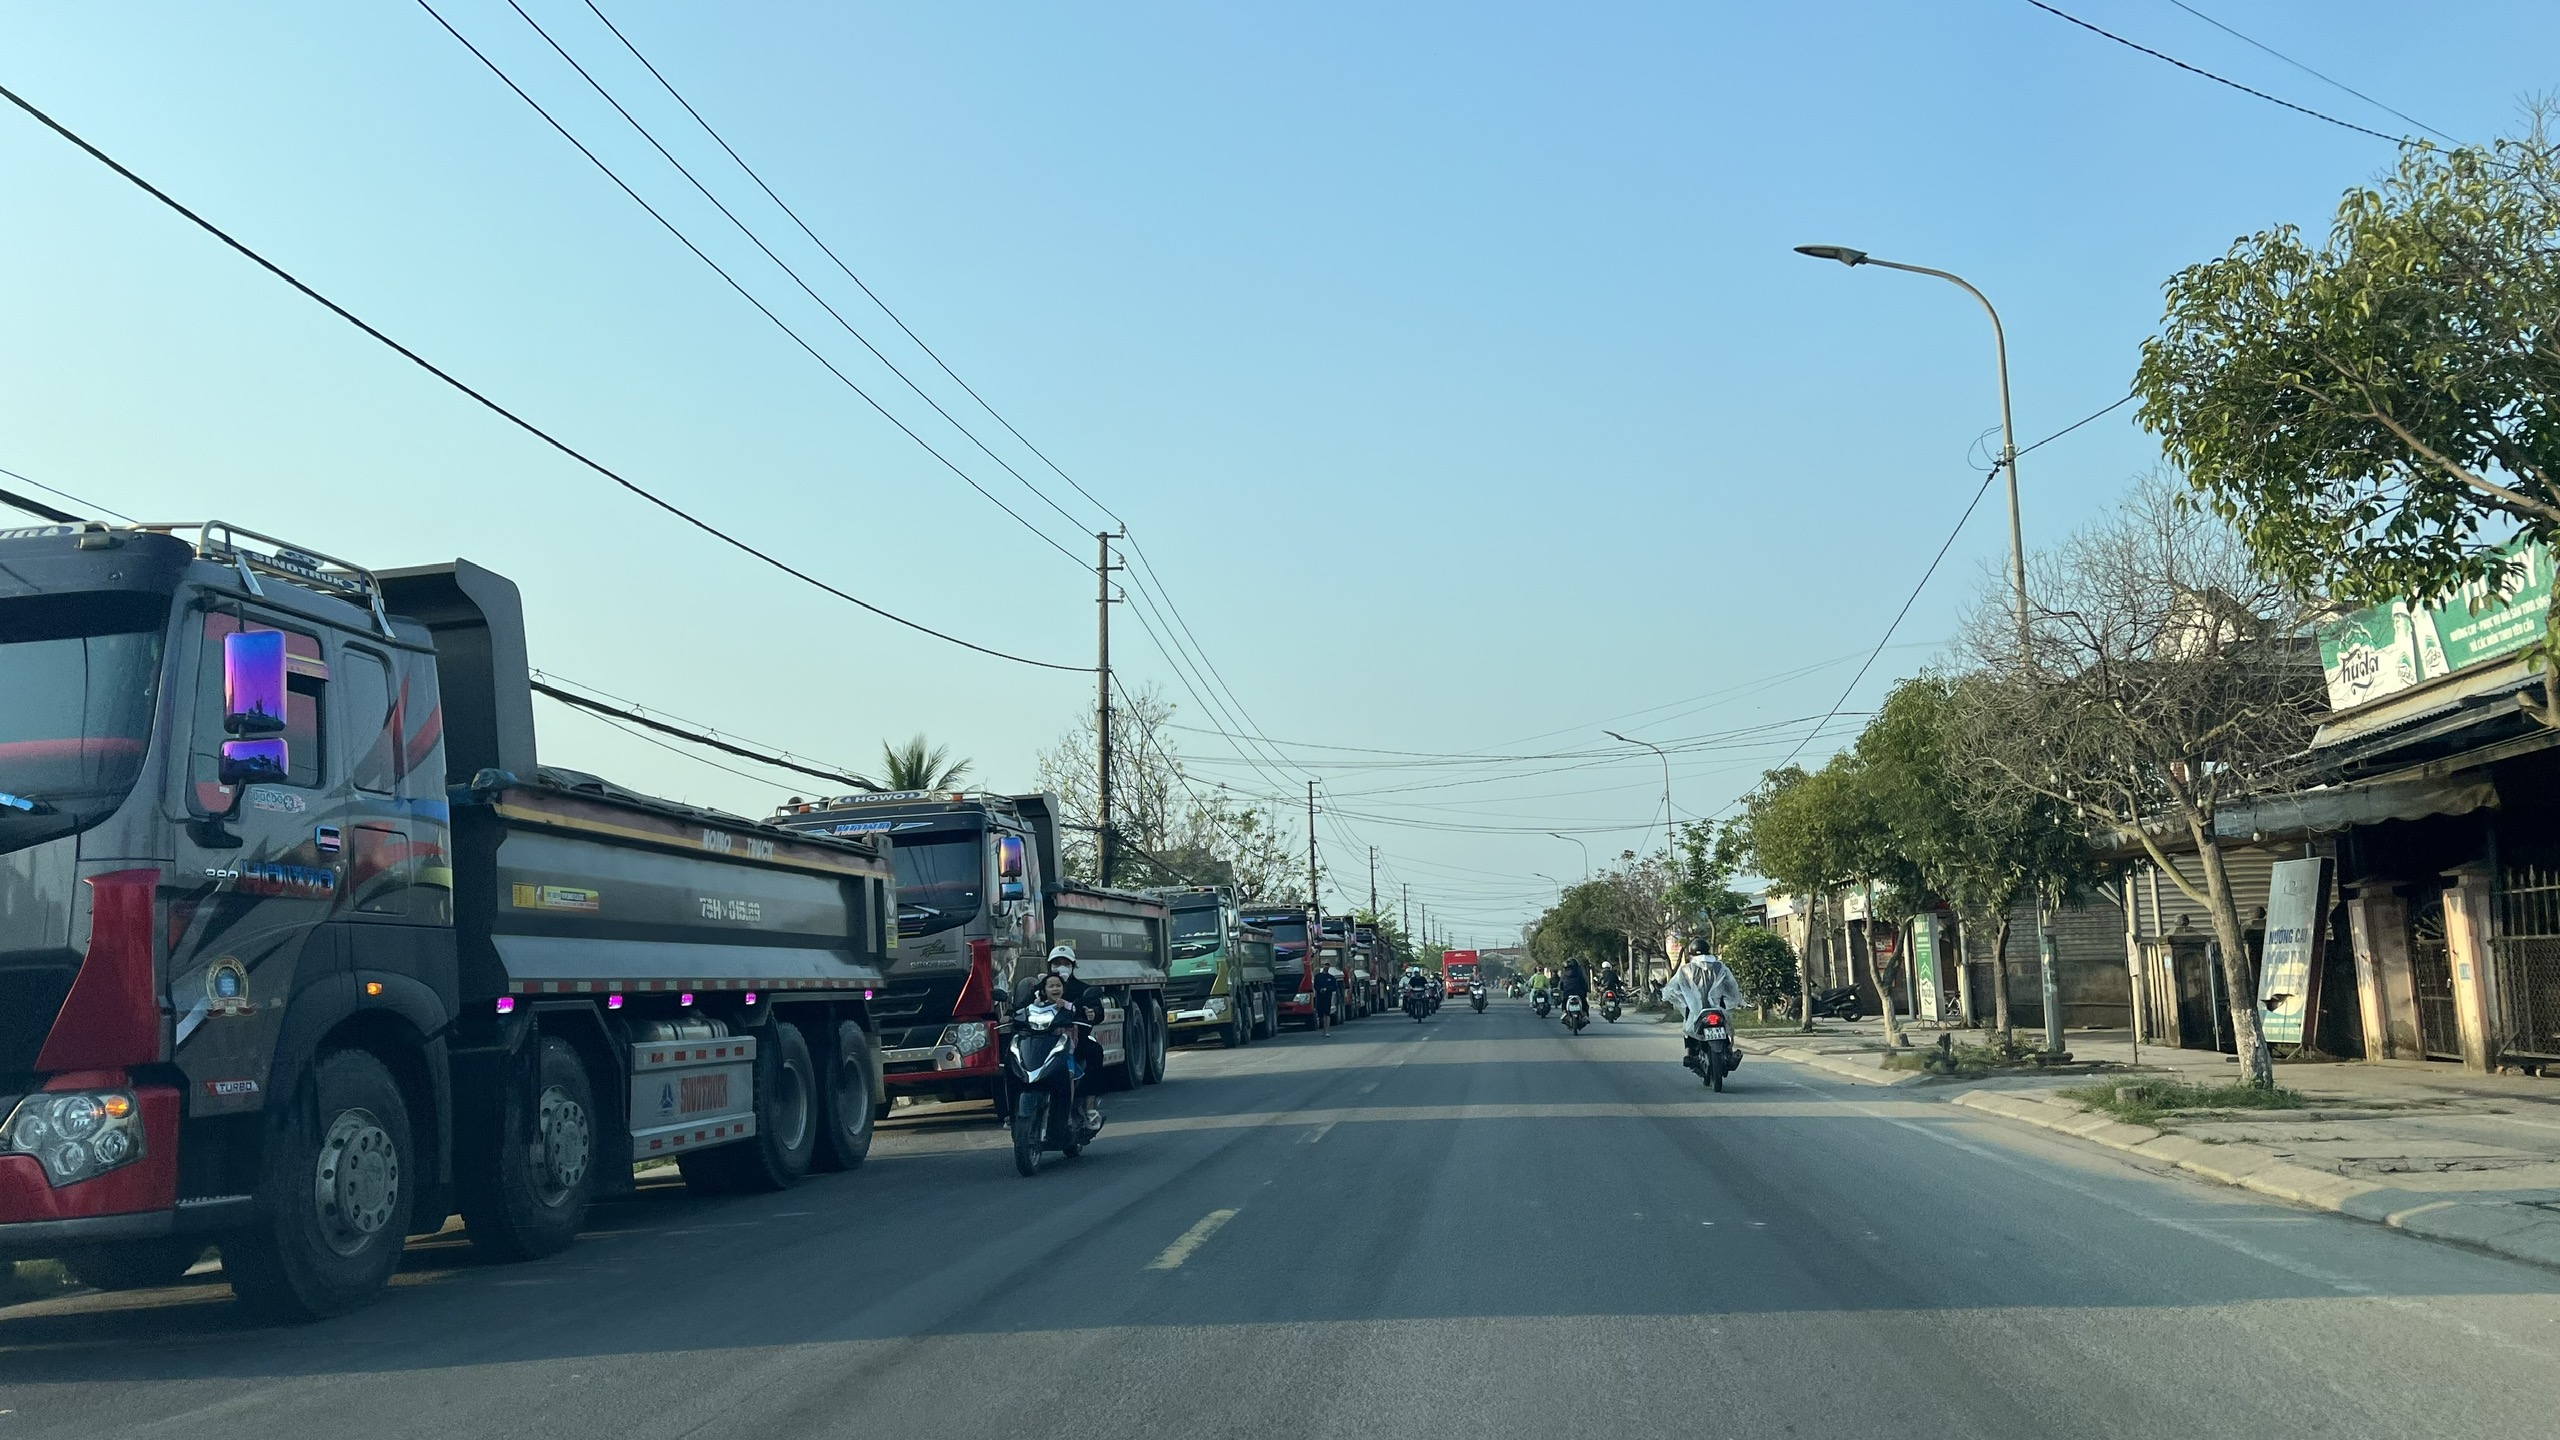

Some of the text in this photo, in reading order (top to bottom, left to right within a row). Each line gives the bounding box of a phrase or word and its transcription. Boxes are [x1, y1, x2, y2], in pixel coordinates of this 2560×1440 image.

[252, 552, 345, 587] SINOTRUK
[855, 793, 906, 803] HOWO
[219, 1081, 252, 1093] TURBO
